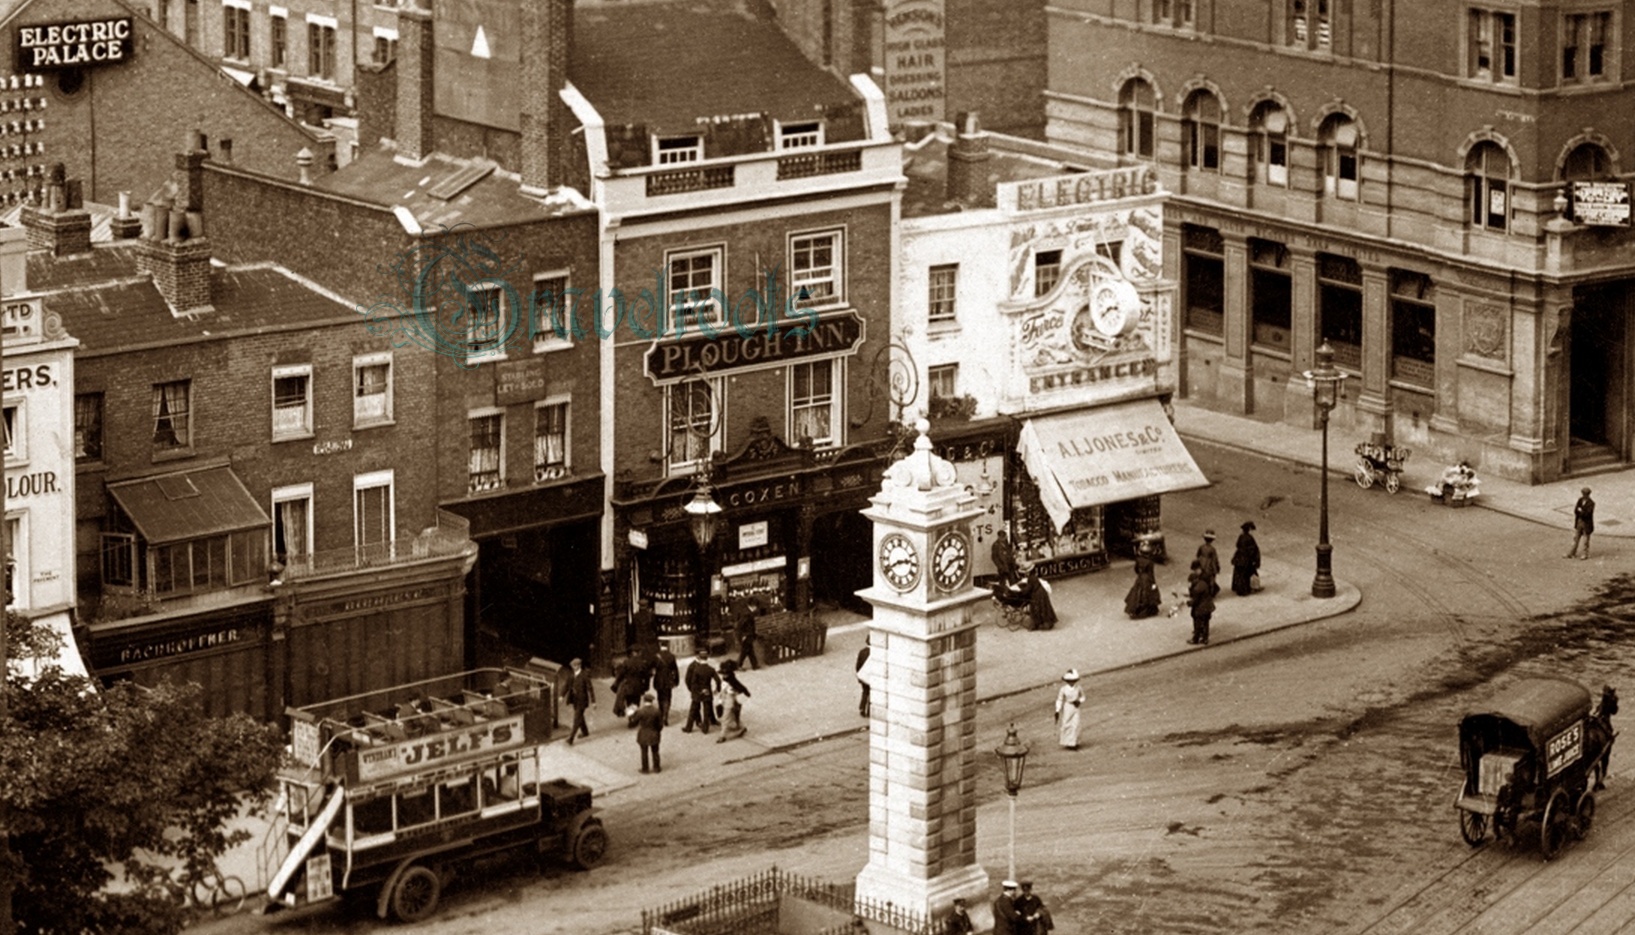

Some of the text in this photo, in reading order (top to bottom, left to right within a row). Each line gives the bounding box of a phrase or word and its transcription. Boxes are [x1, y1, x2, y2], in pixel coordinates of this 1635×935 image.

[20, 20, 130, 47] ELECTRIC
[32, 40, 123, 66] PALACE
[897, 53, 935, 68] HAIR
[888, 86, 944, 103] SALOONS
[1017, 169, 1158, 212] ELECTRIC
[3, 303, 31, 319] TD
[661, 328, 783, 374] PLOUGH
[6, 471, 62, 499] LOUR.
[730, 481, 801, 507] COXEN
[1067, 474, 1110, 492] TOBACCO
